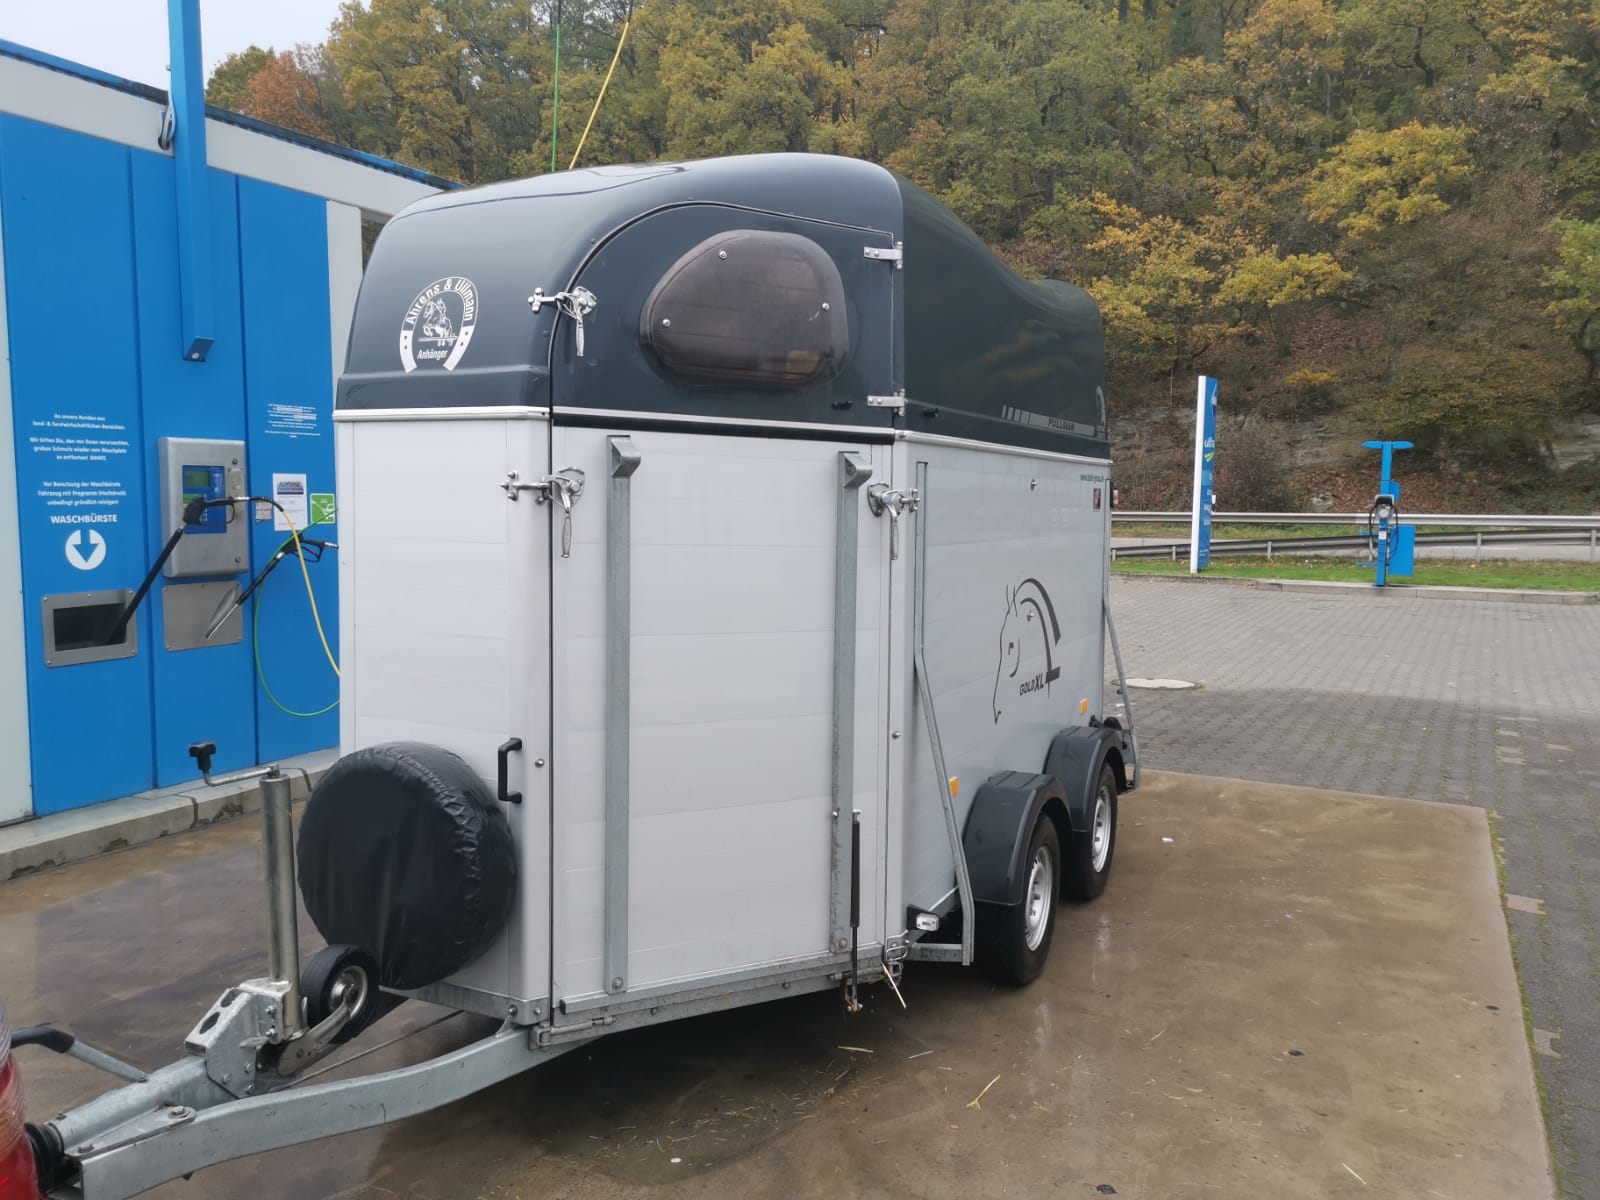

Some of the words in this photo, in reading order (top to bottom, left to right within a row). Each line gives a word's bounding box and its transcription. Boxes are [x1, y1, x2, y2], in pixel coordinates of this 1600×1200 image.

[406, 284, 440, 325] Ahrens
[444, 278, 452, 290] &
[454, 279, 475, 321] Ullmann
[417, 349, 448, 360] Anhänger
[50, 512, 118, 524] WASCHBÜRSTE
